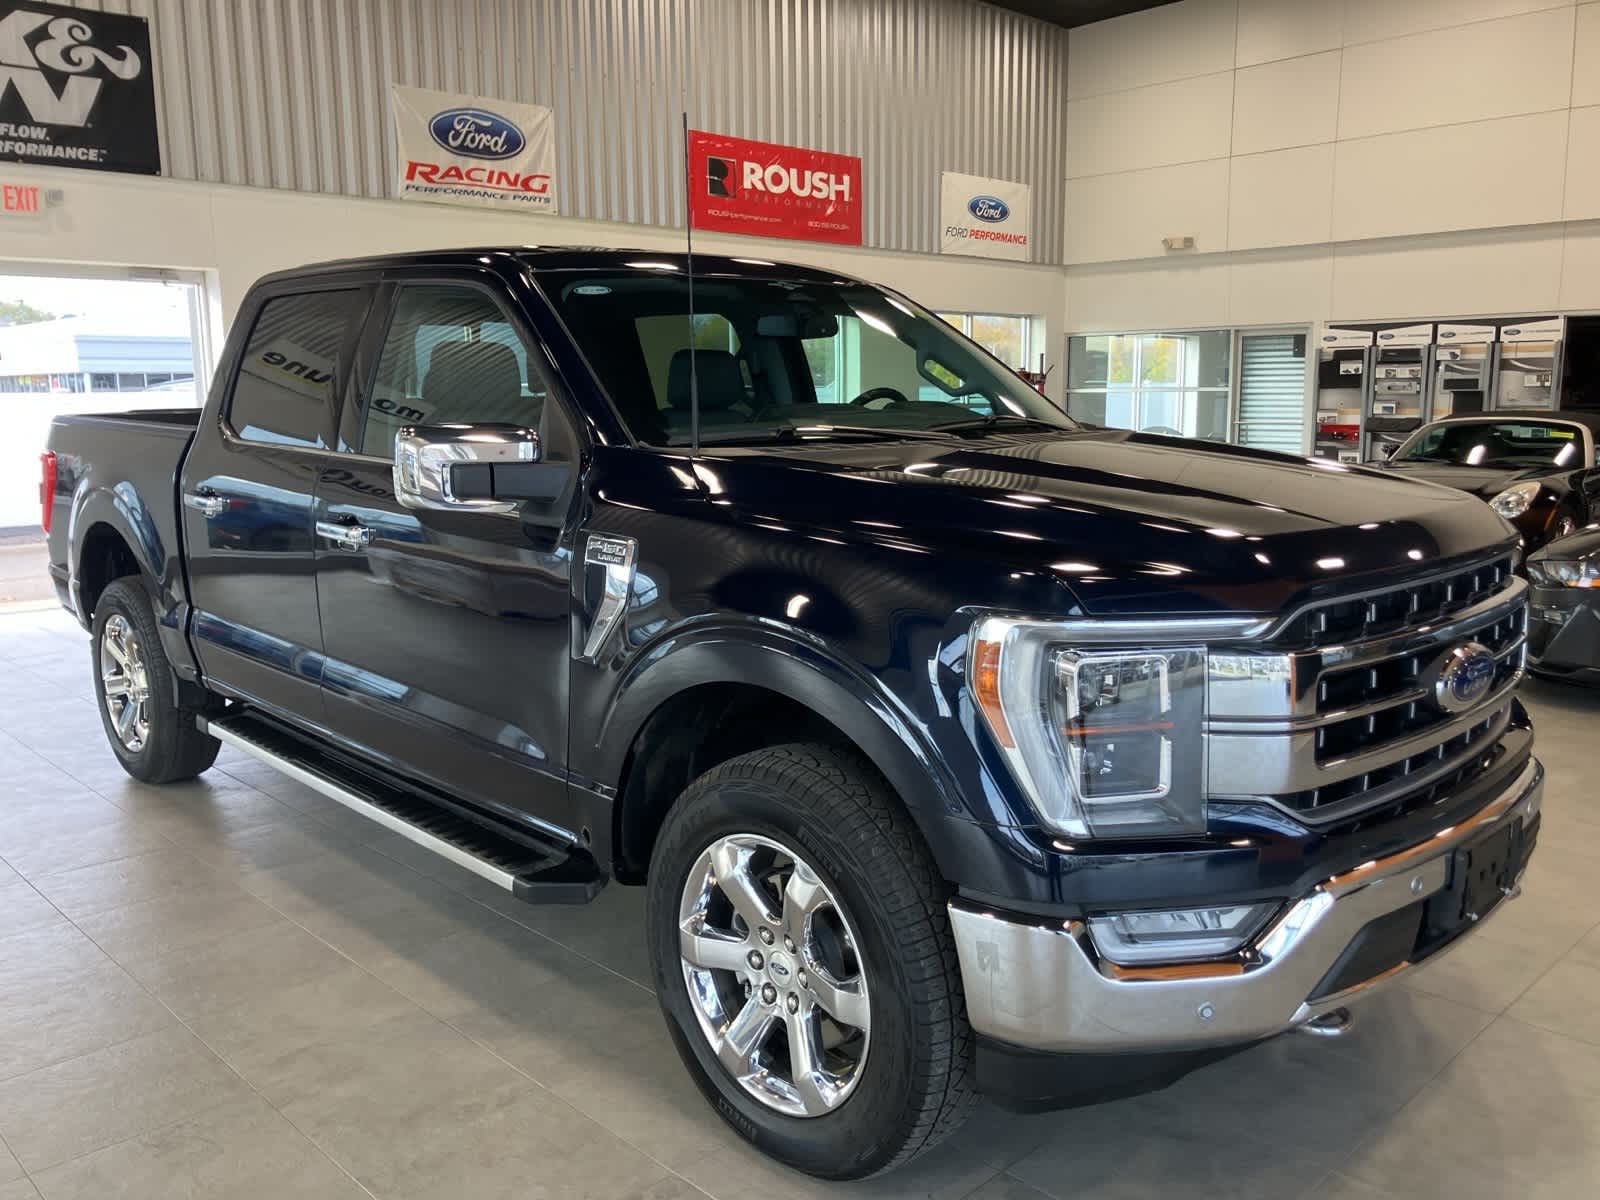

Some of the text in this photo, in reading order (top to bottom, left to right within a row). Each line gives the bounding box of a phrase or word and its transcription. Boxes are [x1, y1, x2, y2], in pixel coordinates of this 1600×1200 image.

[448, 115, 507, 153] Ford
[405, 161, 550, 193] RACING
[743, 161, 850, 201] ROUSH
[3, 185, 39, 212] EXIT
[405, 184, 552, 204] PERFORMANCE PARTS
[975, 199, 1002, 218] Ford
[945, 226, 1028, 245] FORD PERFORMANCE
